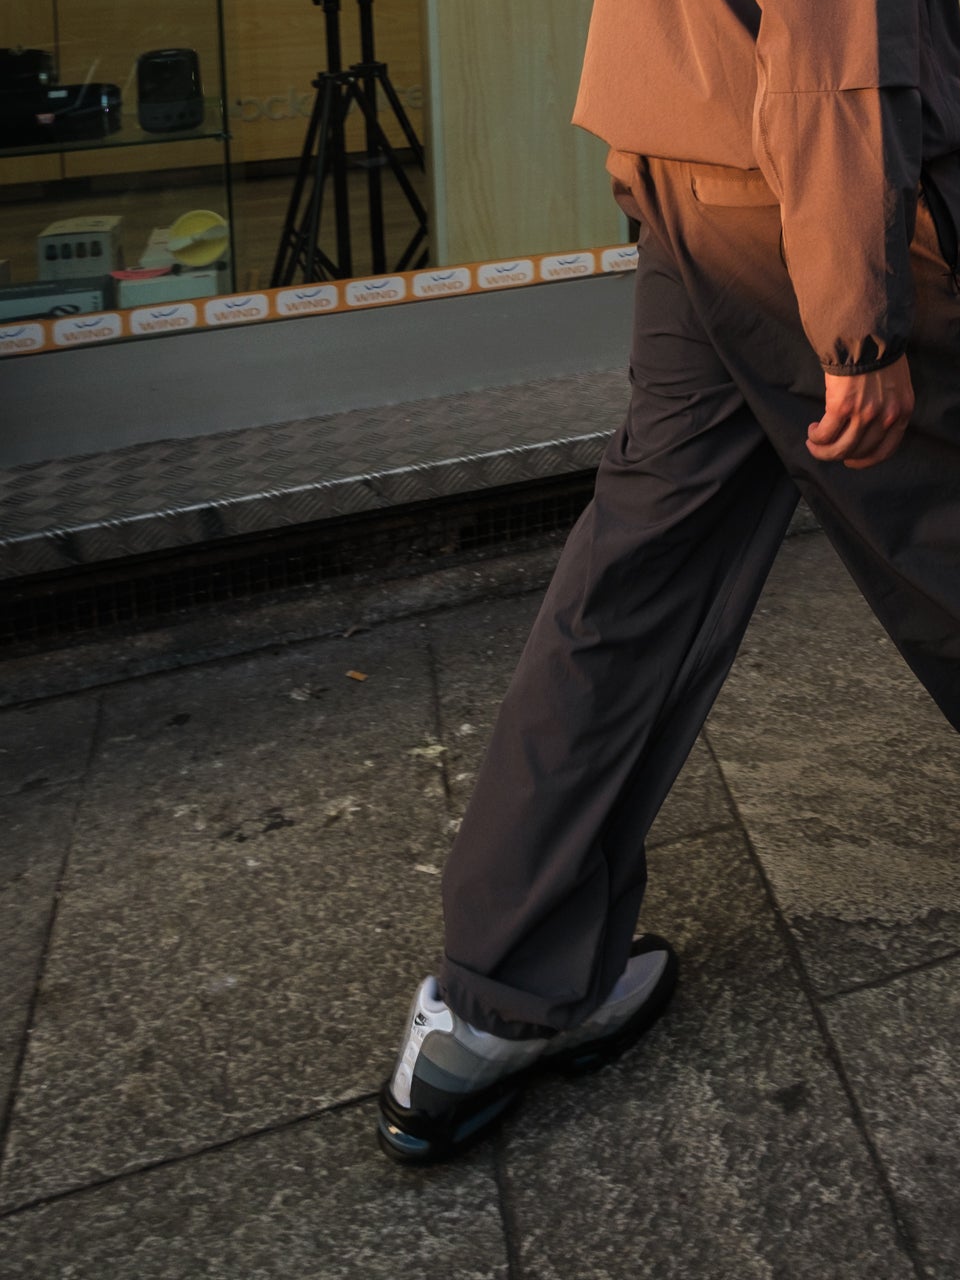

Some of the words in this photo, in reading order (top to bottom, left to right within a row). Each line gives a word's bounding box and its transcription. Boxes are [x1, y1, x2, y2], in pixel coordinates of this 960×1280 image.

[213, 307, 261, 322] WIND
[285, 298, 332, 312] WIND
[353, 289, 399, 304] WIND
[420, 279, 465, 294] WIND
[485, 271, 528, 285] WIND
[547, 265, 589, 278] WIND
